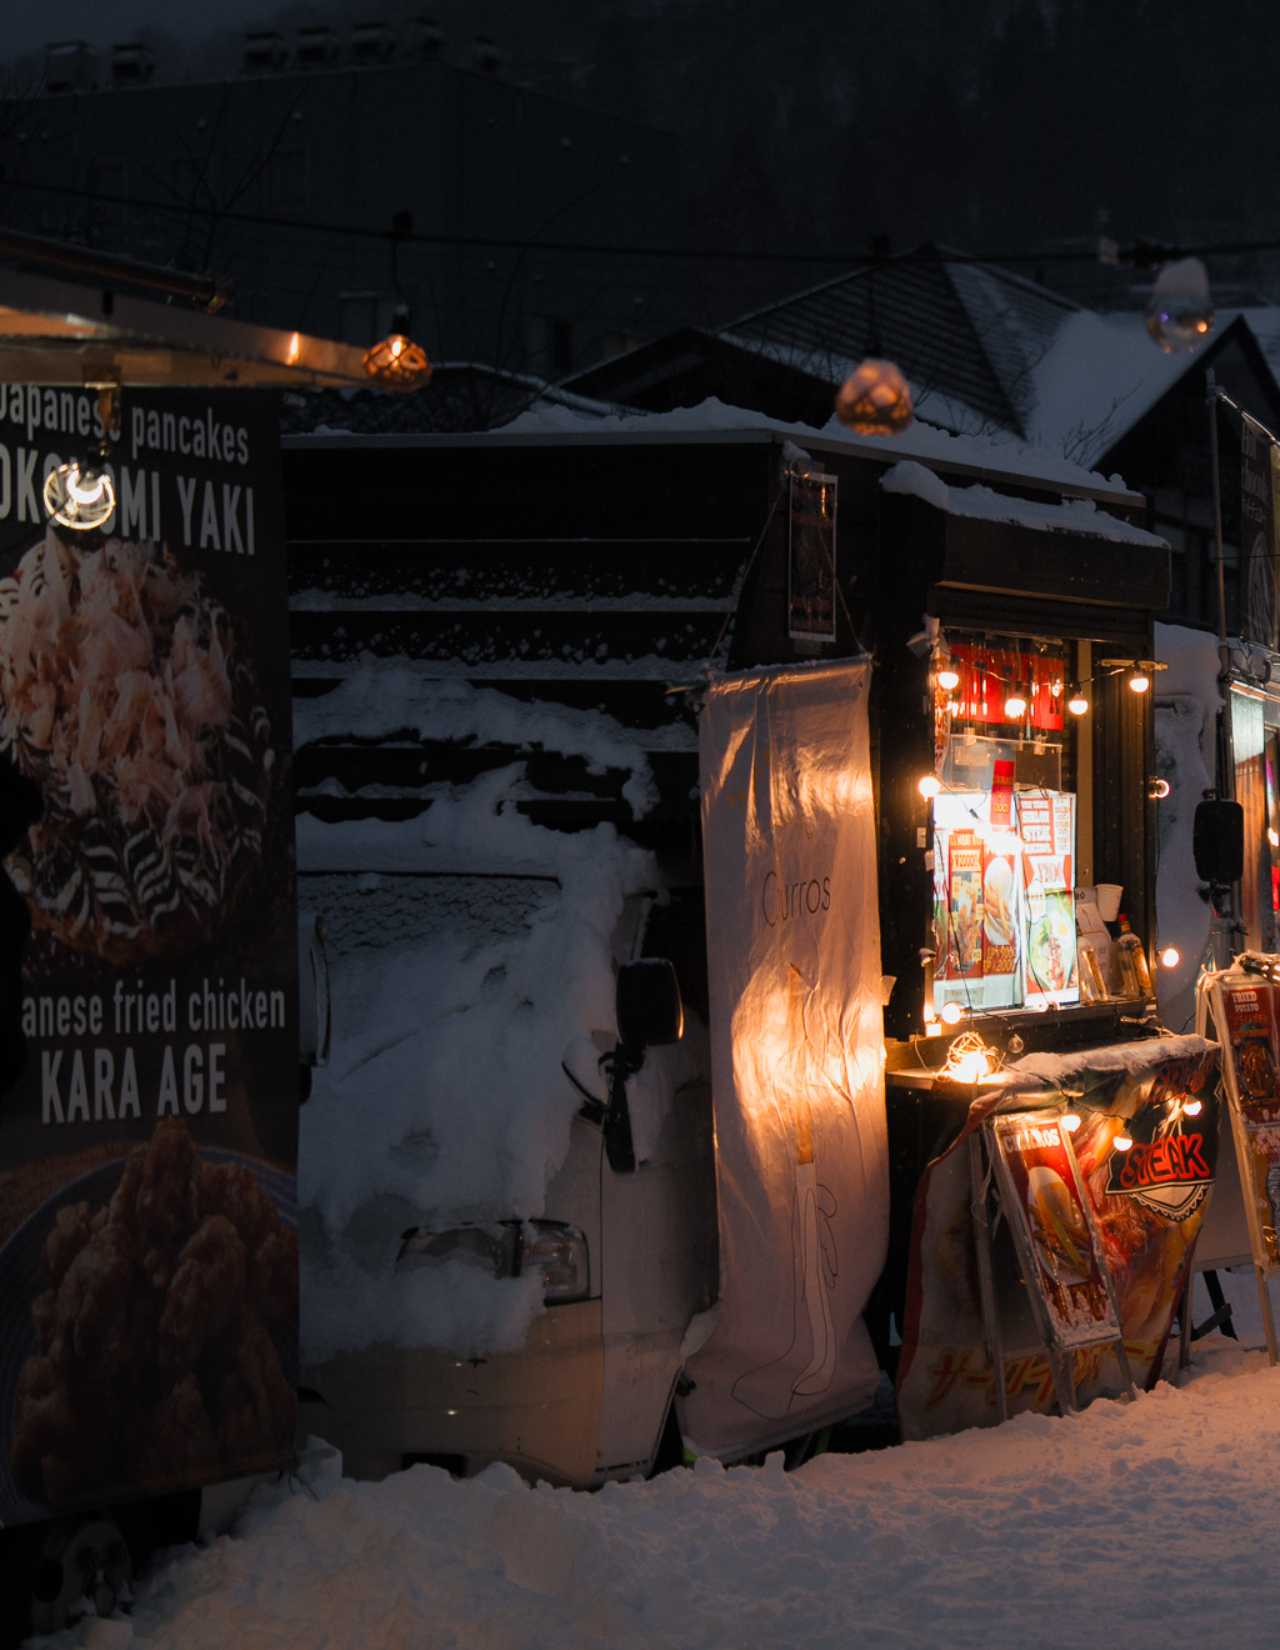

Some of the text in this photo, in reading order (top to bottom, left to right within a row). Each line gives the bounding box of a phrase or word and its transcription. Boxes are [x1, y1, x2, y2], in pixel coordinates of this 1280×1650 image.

[131, 406, 250, 465] pancakes
[176, 474, 256, 556] YAKI
[113, 978, 176, 1035] fried
[188, 977, 286, 1032] chicken
[41, 1042, 228, 1126] KARA AGE
